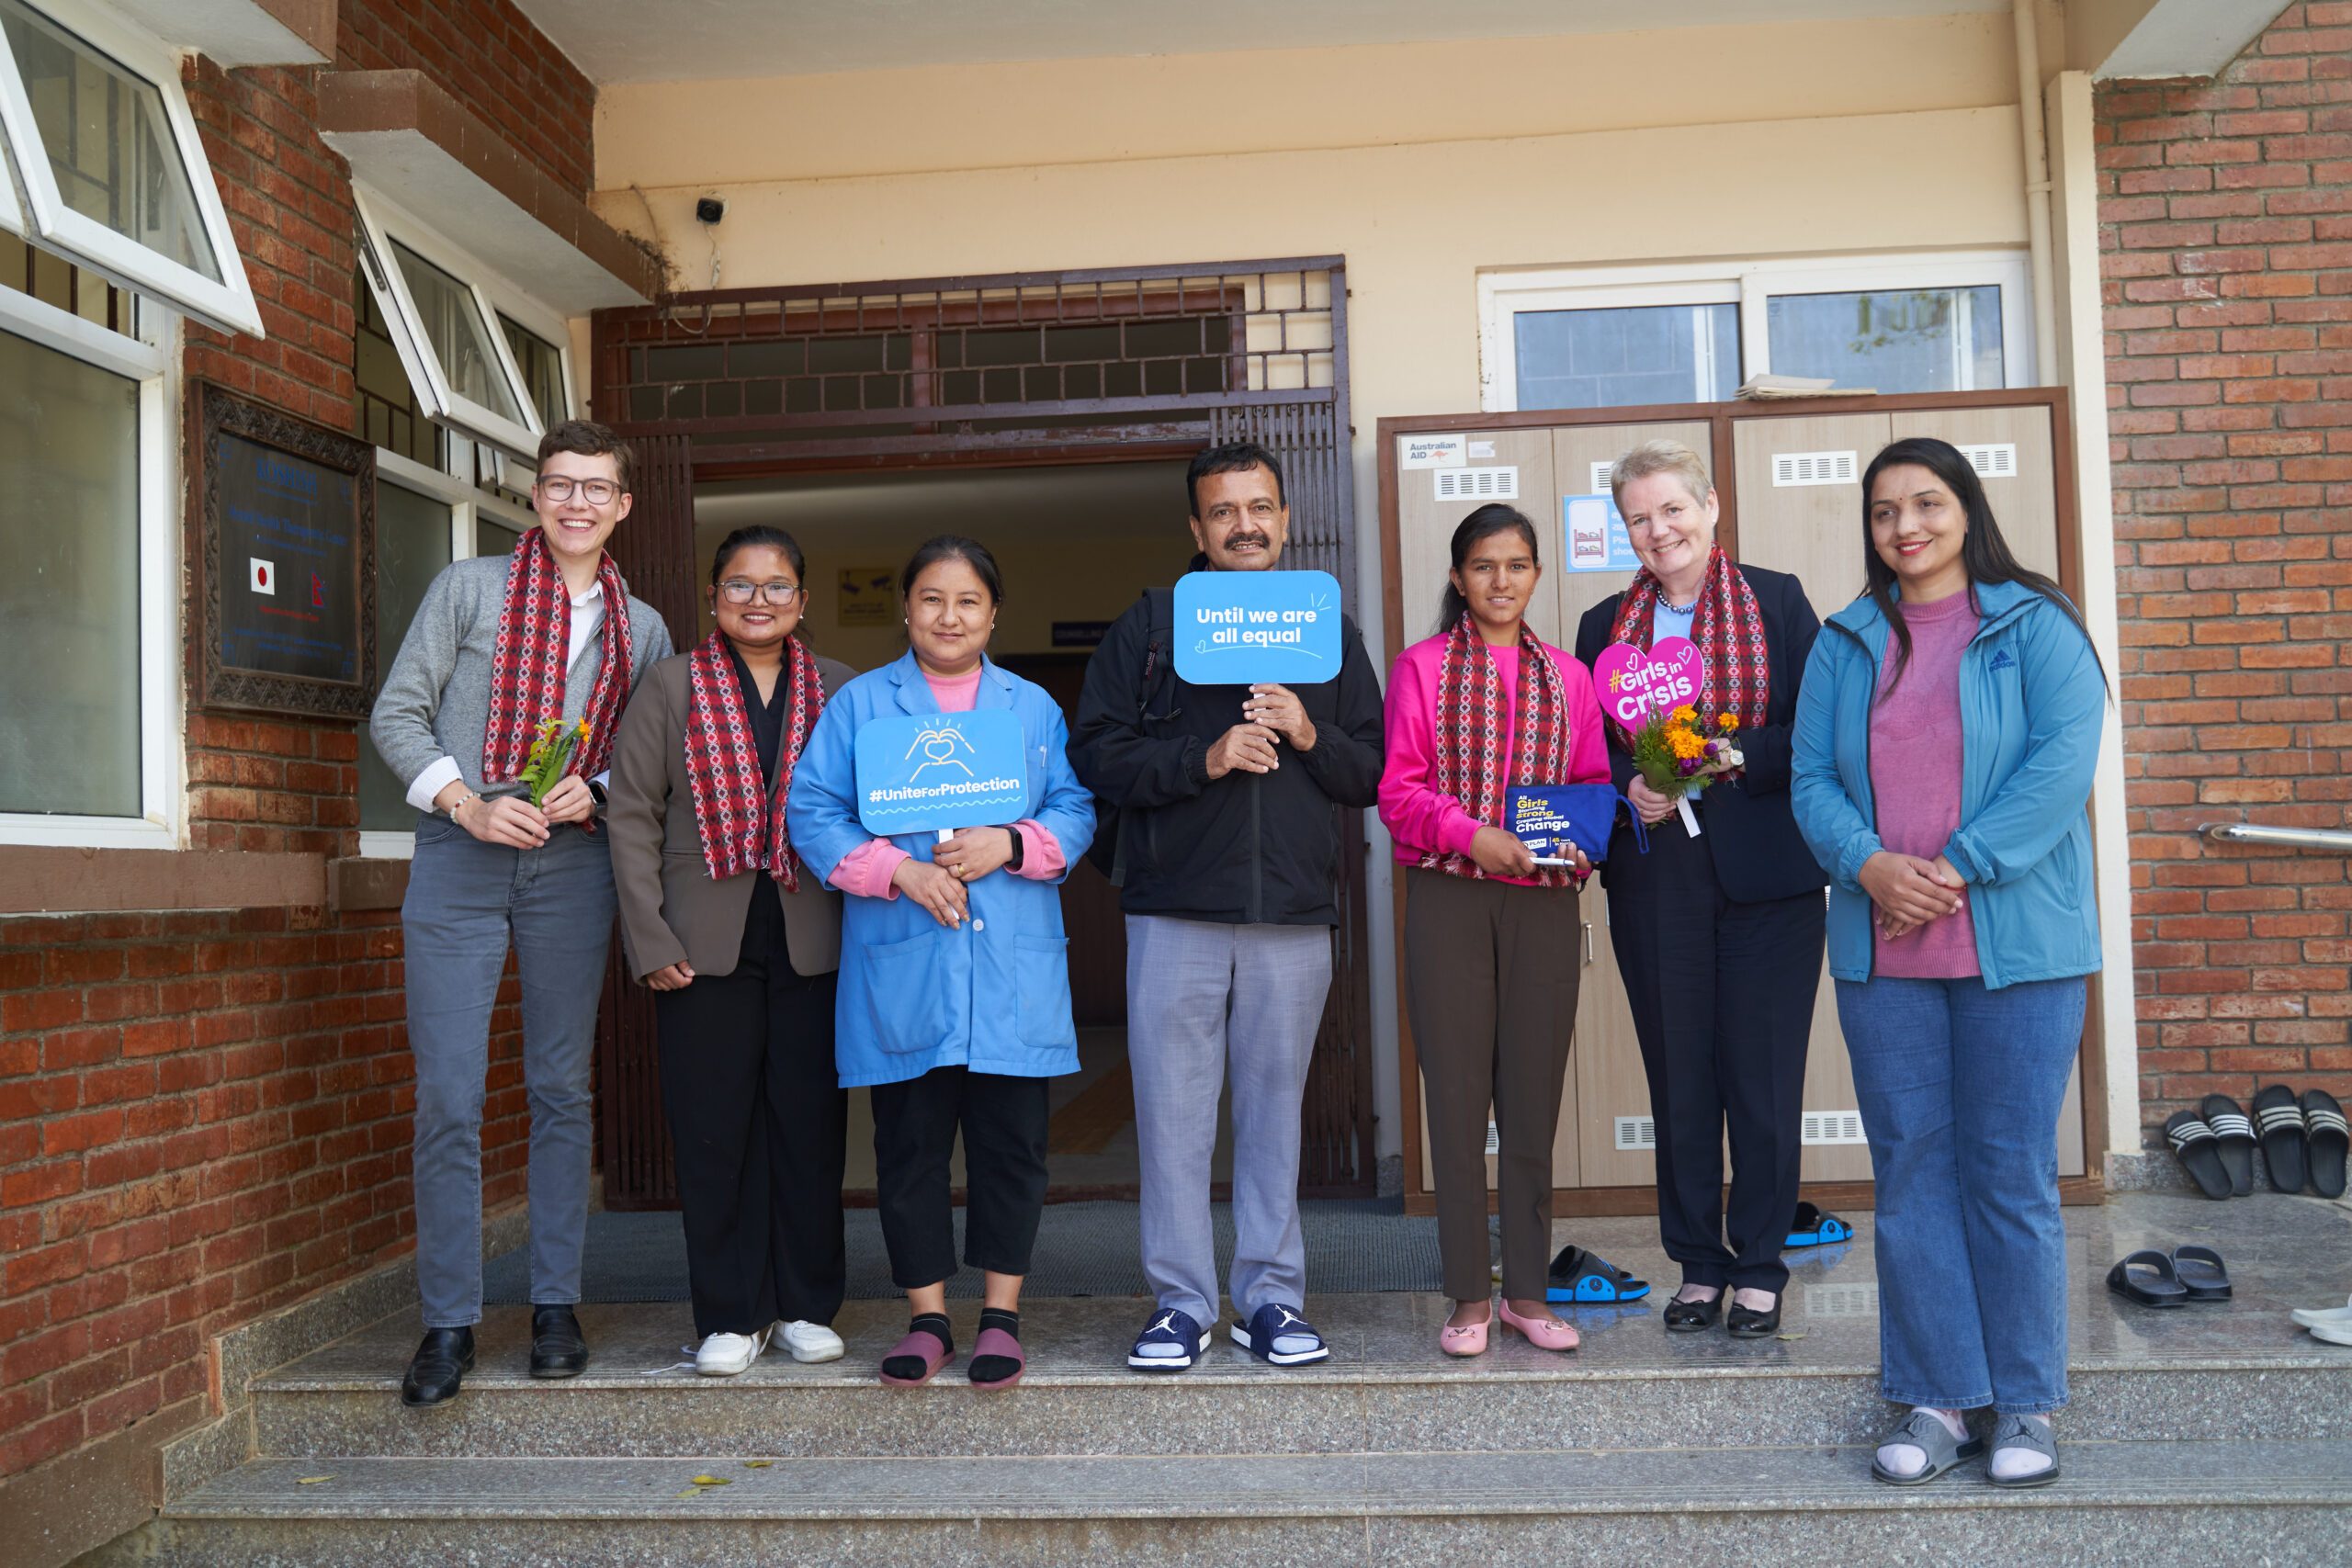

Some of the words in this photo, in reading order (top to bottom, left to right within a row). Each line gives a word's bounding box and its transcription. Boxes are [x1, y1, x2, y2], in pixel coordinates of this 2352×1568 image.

[1410, 442, 1456, 451] Australian
[1410, 451, 1427, 459] AID
[1196, 606, 1244, 624] Until
[1248, 611, 1278, 624] we
[1282, 610, 1317, 624] are
[1212, 627, 1238, 643] all
[1242, 627, 1301, 648] equal
[1989, 661, 2015, 672] adidas
[1609, 661, 1668, 694] #Girls
[1668, 662, 1683, 674] in
[1617, 674, 1693, 720] Crisis
[869, 776, 1020, 802] #UniteForProtection
[1517, 799, 1548, 808] Girls
[1516, 820, 1570, 832] Change
